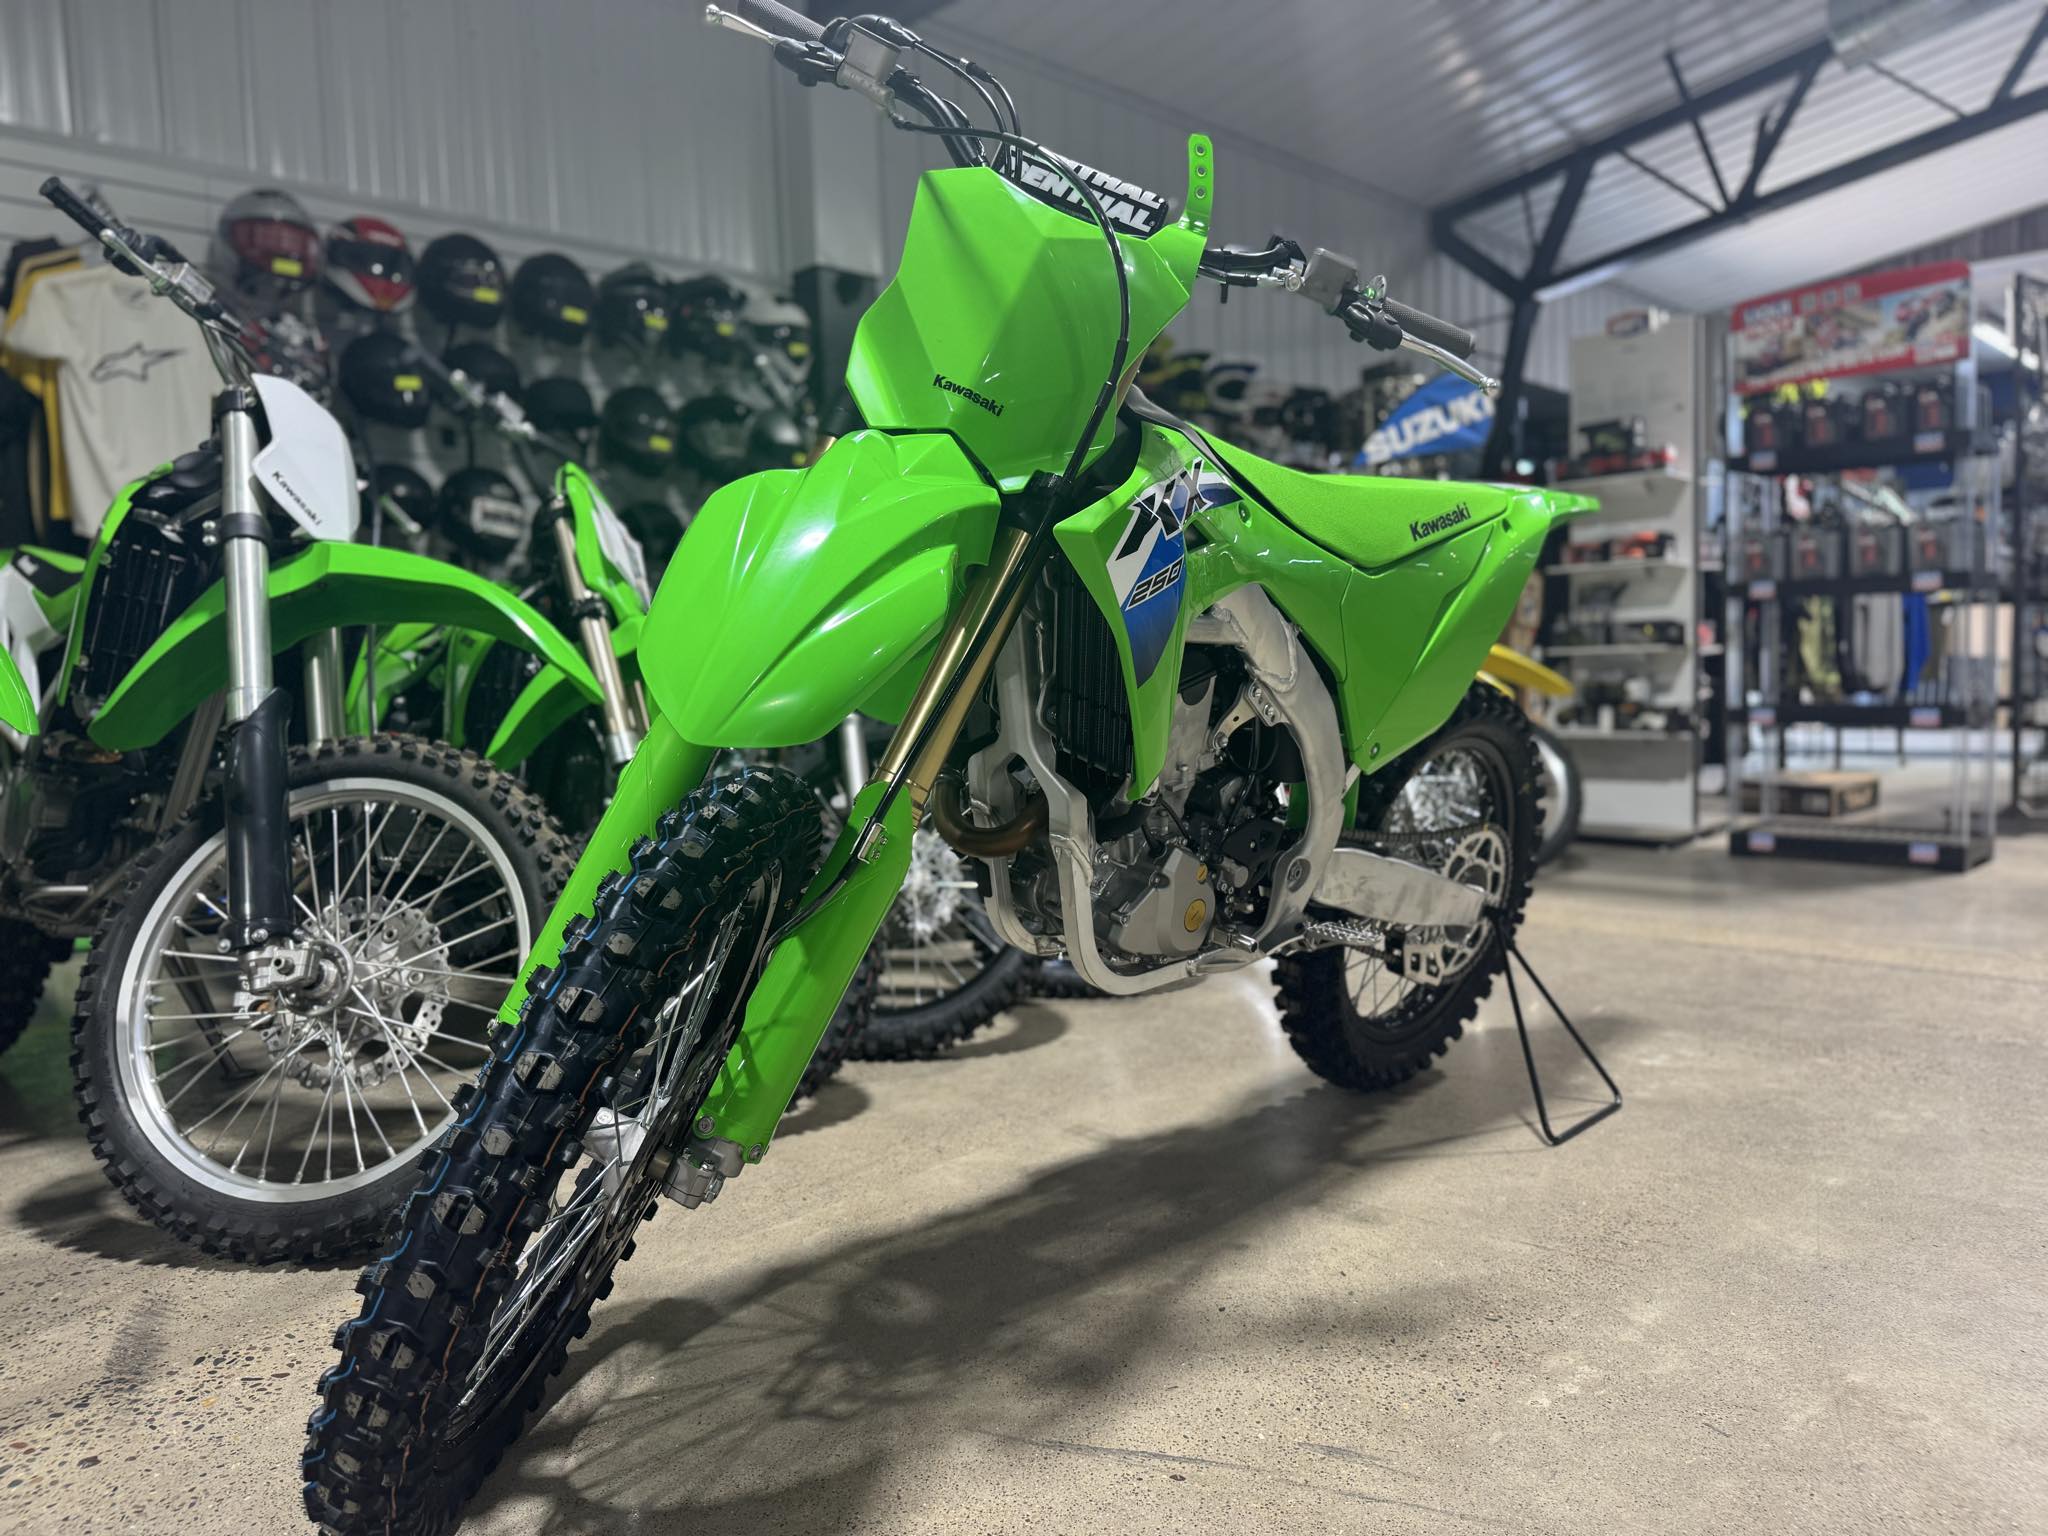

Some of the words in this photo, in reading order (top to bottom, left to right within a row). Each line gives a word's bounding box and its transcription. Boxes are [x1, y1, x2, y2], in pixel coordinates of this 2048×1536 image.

[932, 374, 1004, 417] Kawasaki
[1362, 388, 1496, 465] SUZUKI
[272, 471, 323, 526] Kawasaki
[1113, 457, 1214, 562] KX
[1409, 502, 1472, 542] Kawasaki
[1125, 556, 1185, 612] 250
